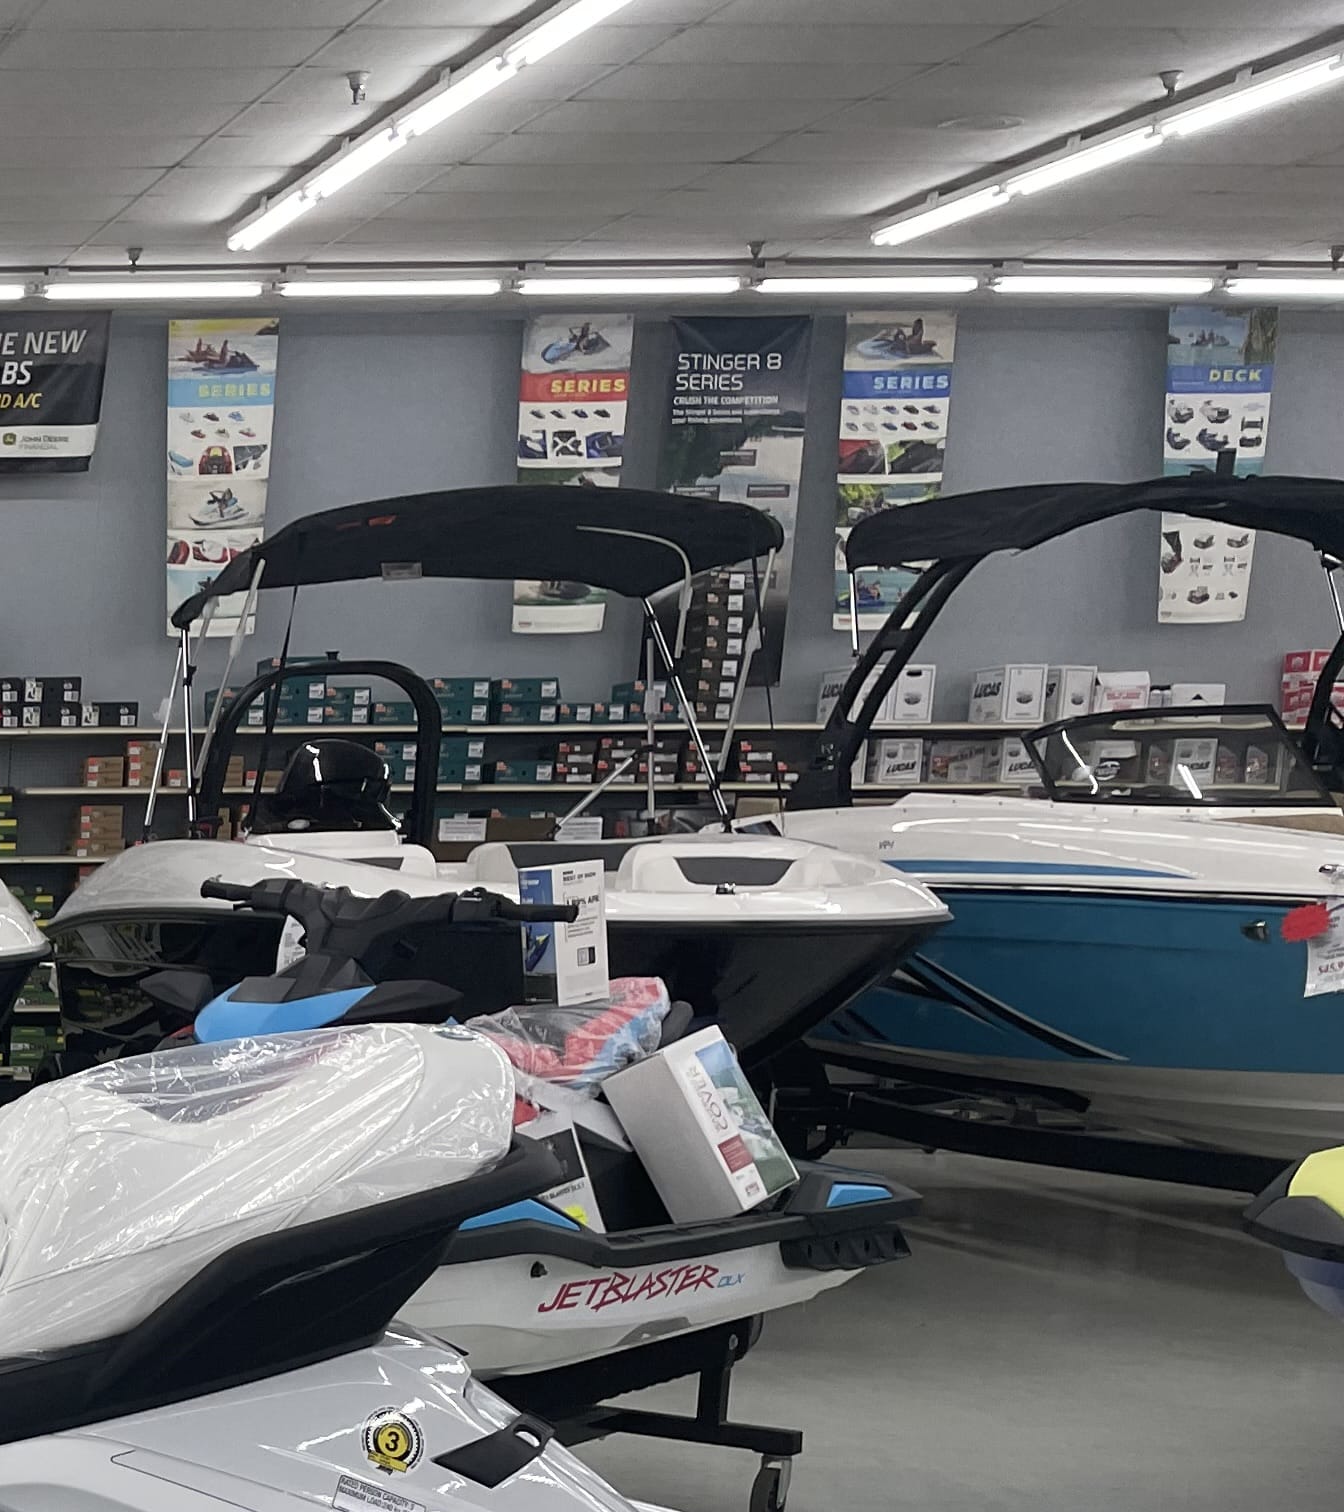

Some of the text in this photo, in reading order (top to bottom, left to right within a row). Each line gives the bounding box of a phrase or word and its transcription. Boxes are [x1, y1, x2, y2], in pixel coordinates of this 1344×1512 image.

[23, 329, 88, 354] NEW
[677, 353, 782, 370] STINGER 8
[676, 374, 744, 390] SERIES
[873, 375, 949, 390] SERIES
[1209, 369, 1263, 382] DECK
[551, 379, 626, 393] SERIES
[13, 392, 42, 409] A/C
[973, 682, 1002, 699] LUCAS
[886, 761, 917, 773] LUCAS
[538, 1264, 720, 1313] JETBLASTER
[385, 1431, 400, 1452] 3
